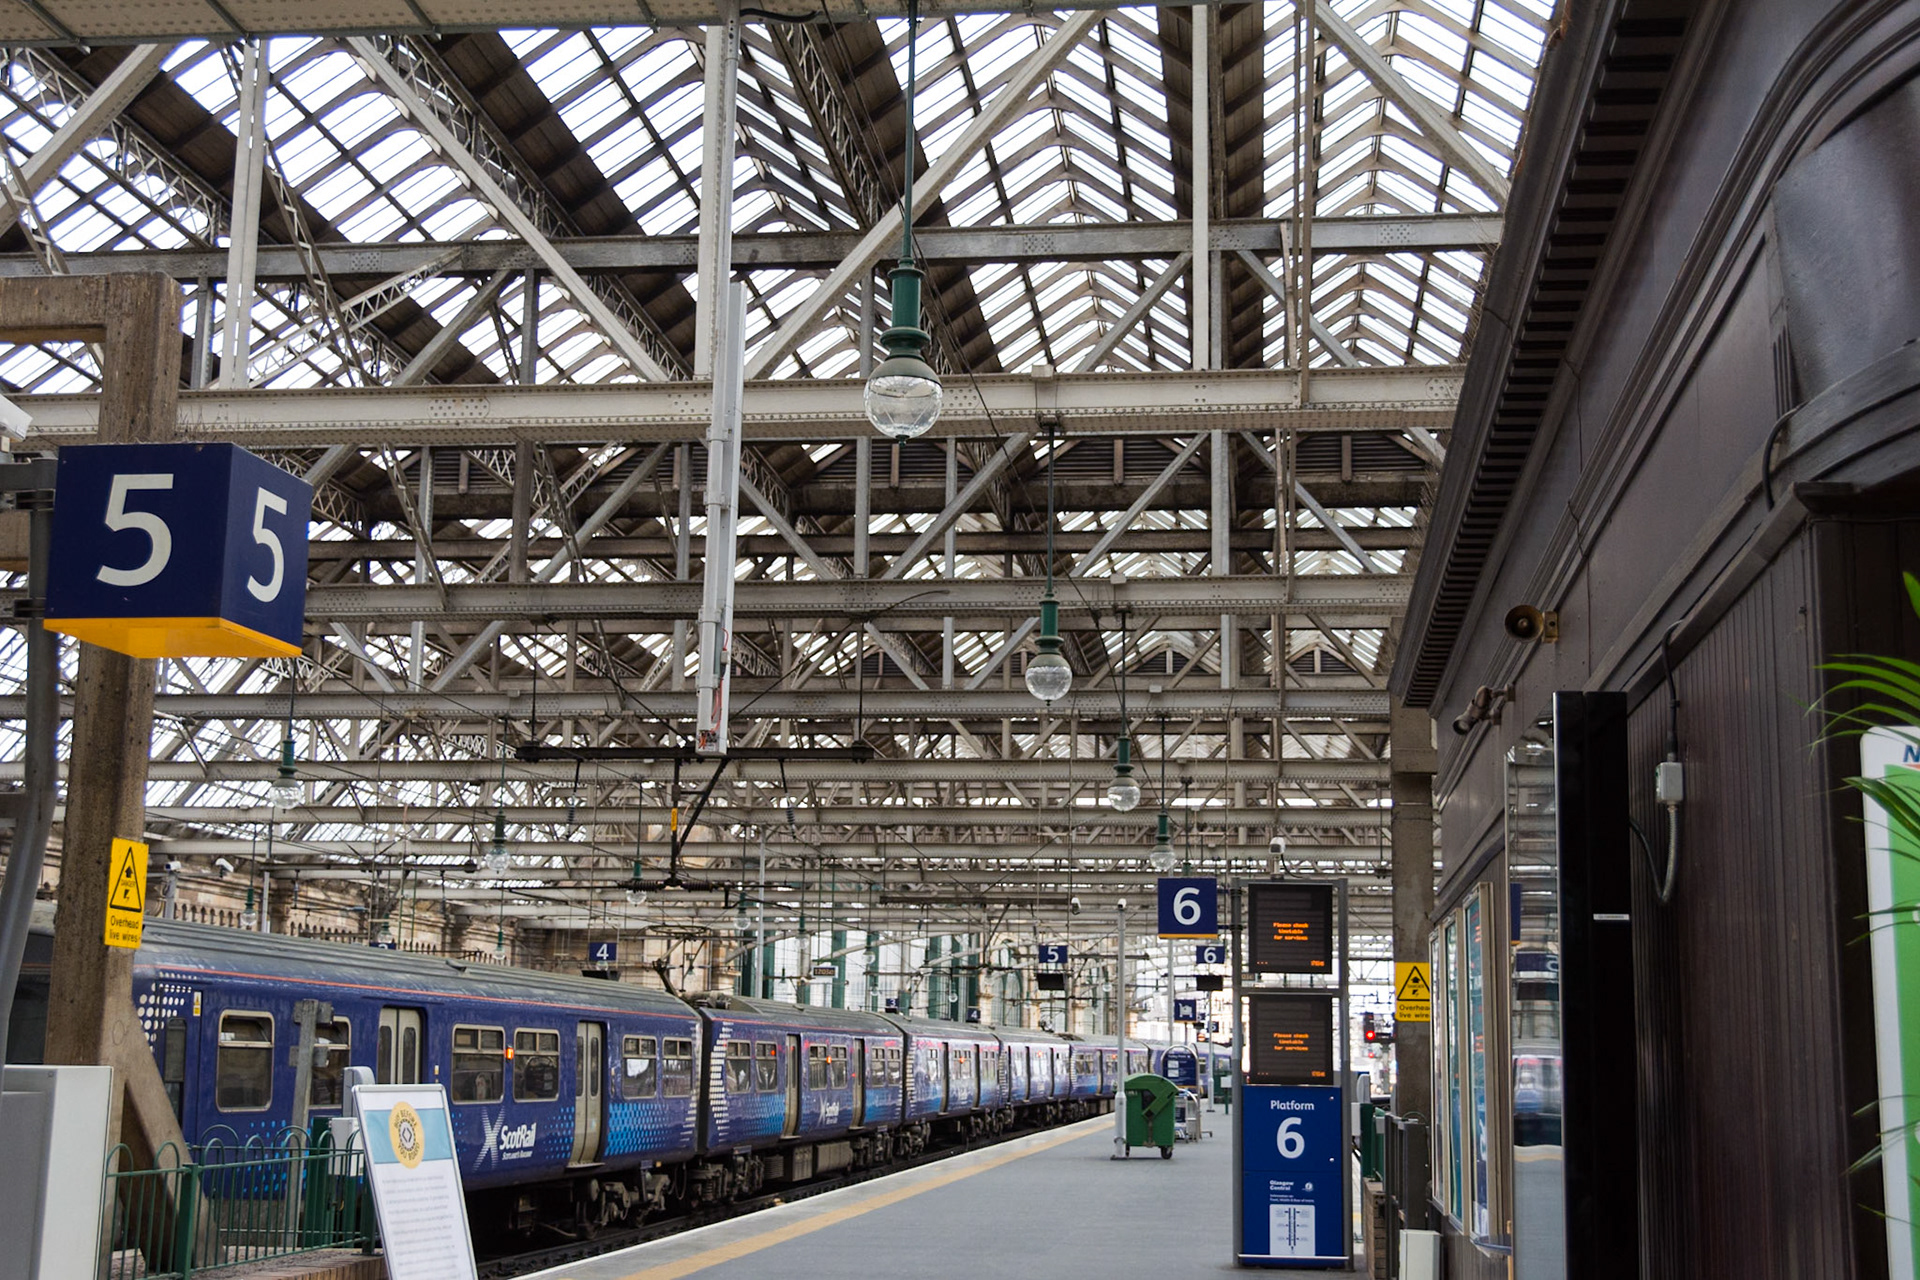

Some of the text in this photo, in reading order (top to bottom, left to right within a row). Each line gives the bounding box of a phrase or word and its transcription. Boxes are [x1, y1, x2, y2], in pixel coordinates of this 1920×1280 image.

[96, 473, 174, 587] 5
[247, 487, 288, 603] 5
[1173, 886, 1201, 926] 6
[110, 915, 139, 930] Overhead
[109, 929, 138, 943] live wires
[596, 943, 609, 960] 4
[1047, 946, 1059, 963] 5
[1204, 946, 1217, 964] 6
[1270, 1100, 1315, 1110] Platform
[499, 1122, 537, 1150] ScotRail
[1276, 1116, 1305, 1159] 6
